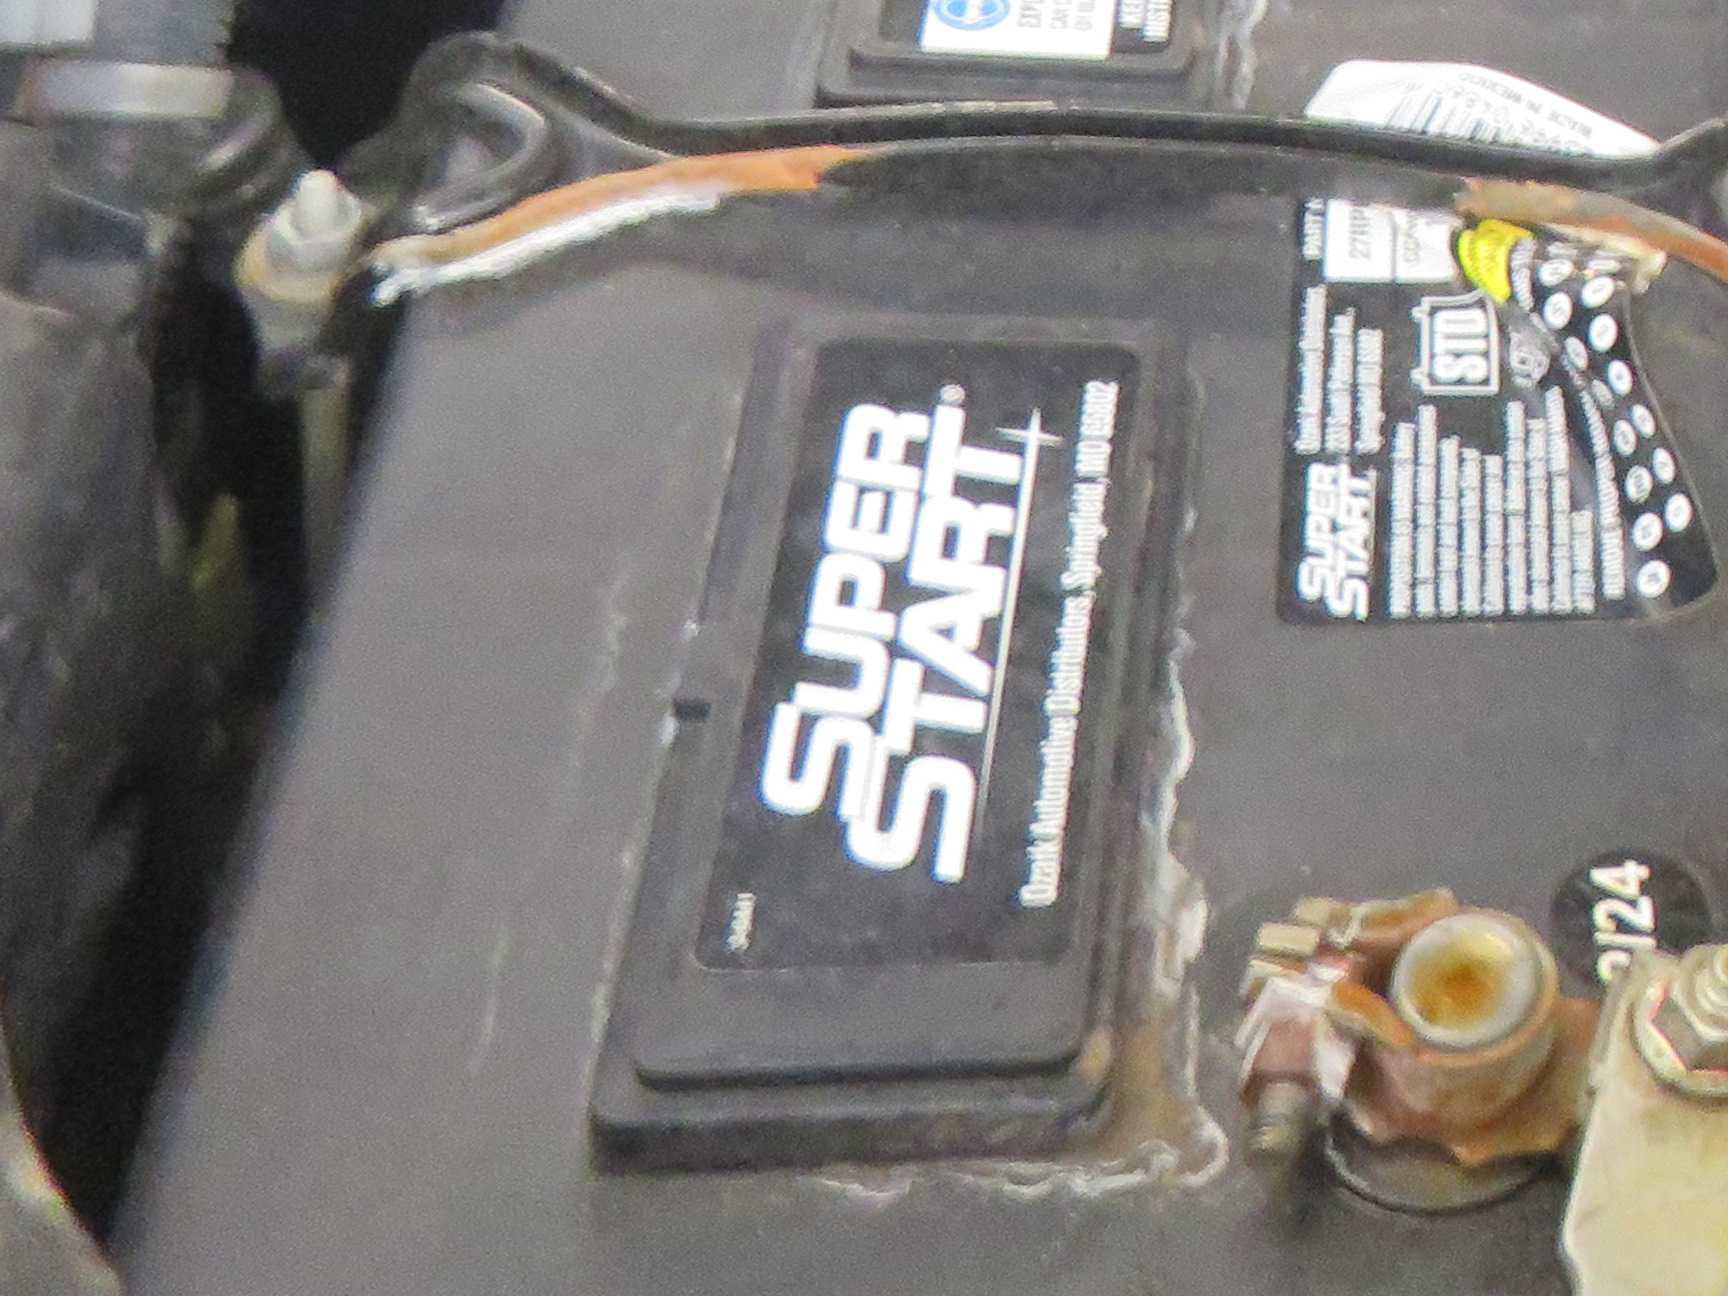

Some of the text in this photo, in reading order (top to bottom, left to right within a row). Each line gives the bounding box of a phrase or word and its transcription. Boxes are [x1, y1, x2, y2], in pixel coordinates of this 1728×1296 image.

[1432, 306, 1488, 384] STD
[1073, 440, 1112, 476] MO
[1296, 461, 1337, 601] SUPER
[1325, 462, 1371, 622] START
[761, 402, 930, 816] SUPER
[846, 404, 1025, 882] START
[1026, 718, 1079, 834] Automotive
[1016, 840, 1062, 906] Ozark
